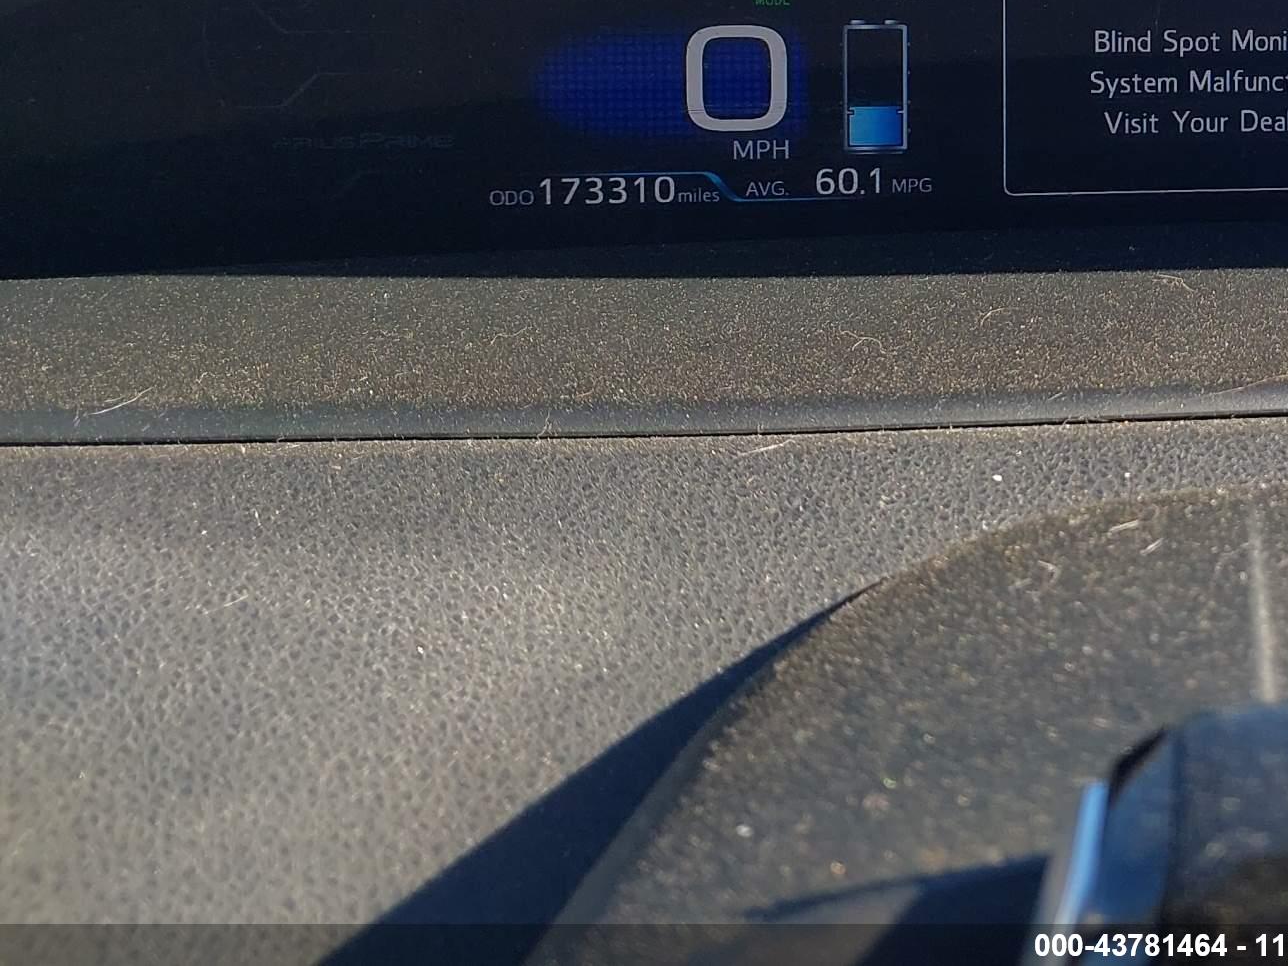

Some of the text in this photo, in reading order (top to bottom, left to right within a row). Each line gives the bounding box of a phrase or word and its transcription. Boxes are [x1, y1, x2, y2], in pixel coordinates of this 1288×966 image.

[1095, 30, 1150, 52] Blind
[1164, 30, 1220, 57] Spot
[686, 25, 787, 131] 0
[1091, 71, 1177, 98] System
[1104, 112, 1158, 133] Visit
[1173, 111, 1228, 132] Your
[734, 140, 789, 159] MPH
[490, 176, 720, 205] ODO 173310 miles
[746, 168, 931, 196] AVG. 60.1 MPG
